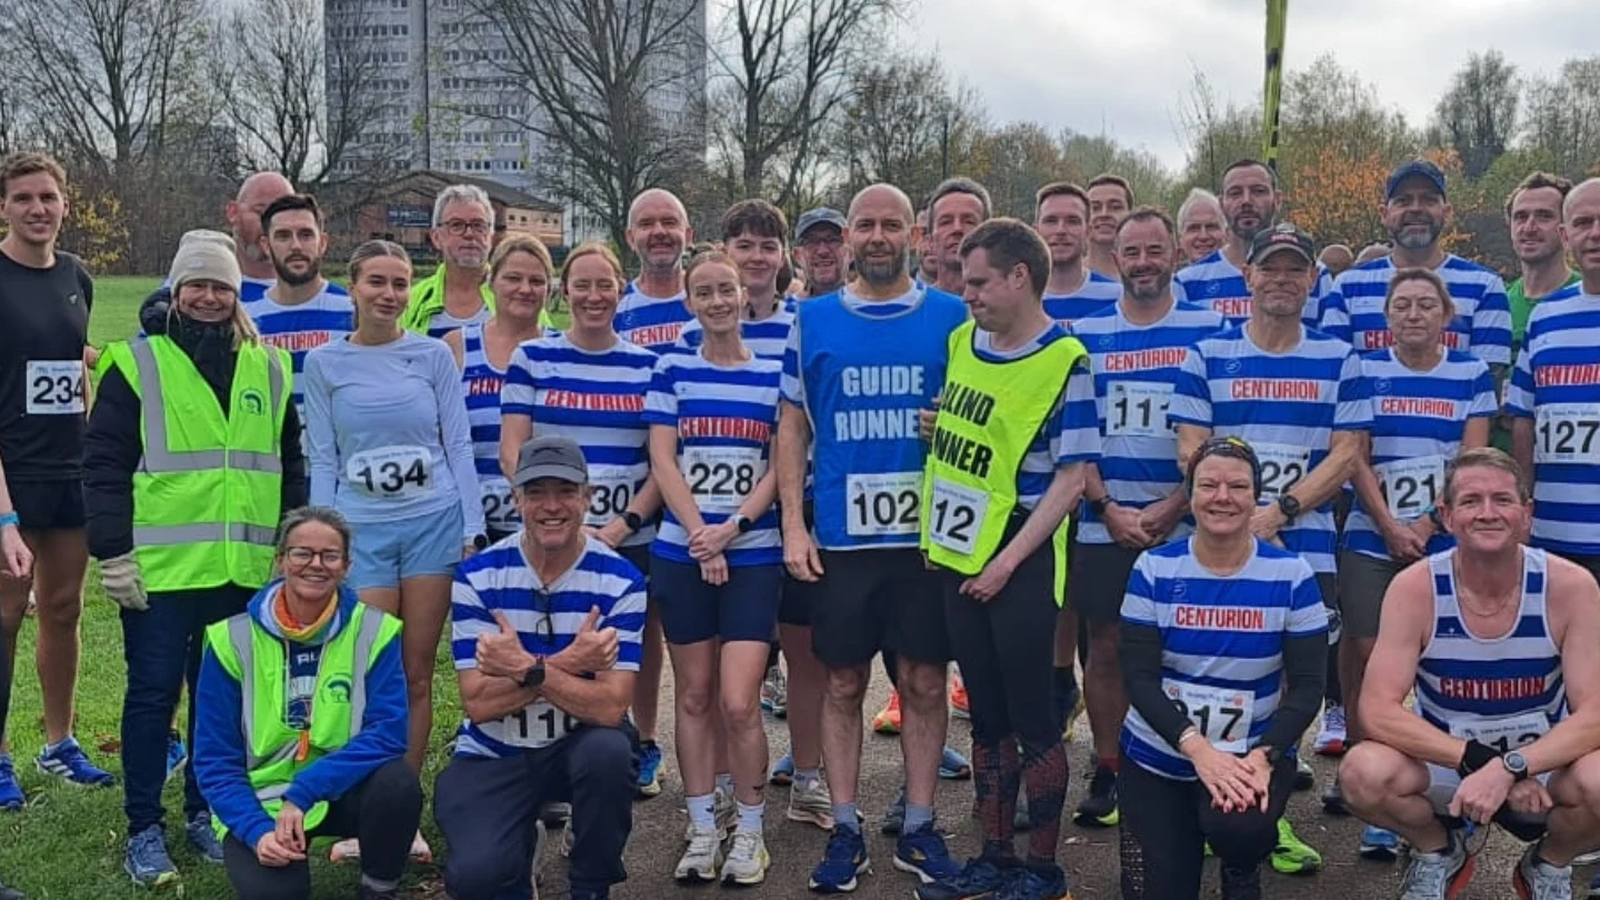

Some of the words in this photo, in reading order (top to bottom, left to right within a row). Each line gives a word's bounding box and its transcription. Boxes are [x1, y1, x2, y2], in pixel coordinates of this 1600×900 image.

[261, 331, 330, 350] ENTURION
[1106, 348, 1187, 371] CENTURION
[841, 365, 924, 397] GUIDE
[1232, 379, 1319, 400] CENTURION
[545, 389, 645, 412] CENTURION
[1381, 397, 1455, 418] CENTURION
[680, 417, 770, 441] CENTURION
[834, 407, 920, 442] RUNNE
[1540, 420, 1600, 454] 127
[934, 426, 994, 478] NNER
[357, 458, 428, 493] 134
[690, 463, 754, 496] 228
[854, 490, 920, 526] 102
[936, 499, 976, 542] 12
[1176, 606, 1264, 630] CENTURION
[1440, 677, 1546, 698] CENTURION
